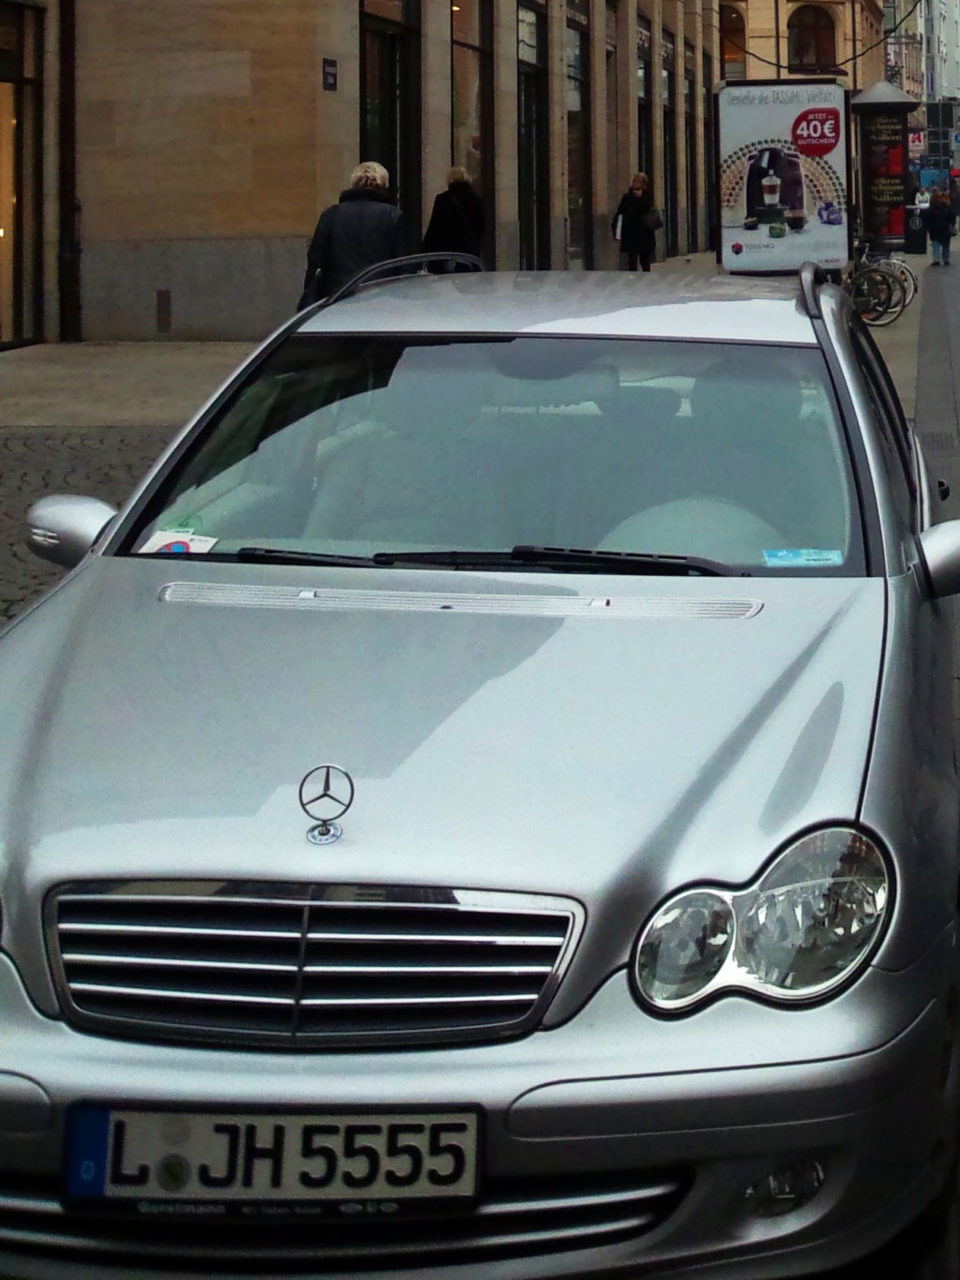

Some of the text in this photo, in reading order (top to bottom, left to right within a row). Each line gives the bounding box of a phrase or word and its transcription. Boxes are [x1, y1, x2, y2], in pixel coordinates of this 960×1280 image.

[111, 1120, 468, 1188] L JH 5555
